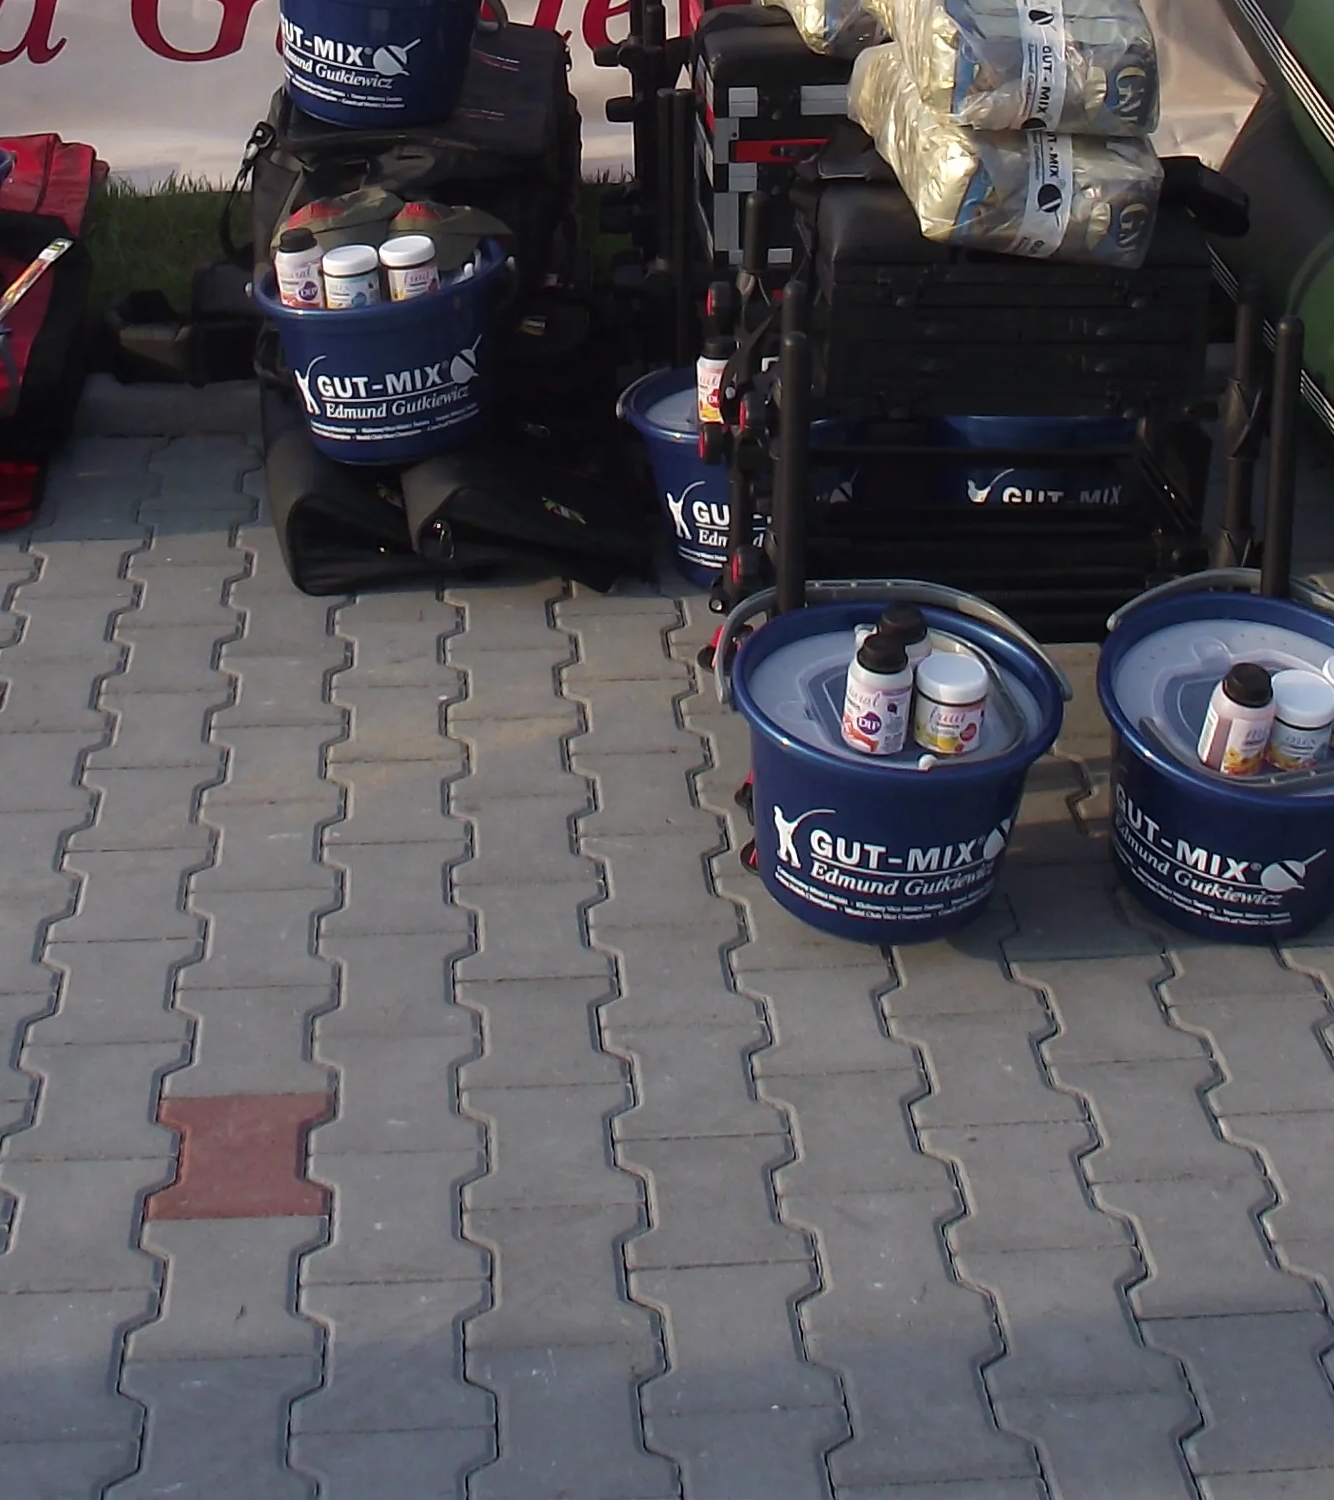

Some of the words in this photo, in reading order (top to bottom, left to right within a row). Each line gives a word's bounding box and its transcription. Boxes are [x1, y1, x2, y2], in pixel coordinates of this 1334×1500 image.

[315, 62, 394, 89] Gutkiewicz
[318, 362, 444, 398] GUT-MIX
[325, 402, 387, 420] Edmund
[391, 386, 469, 416] Gutkiewicz
[810, 829, 978, 872] GUT-MIX
[810, 860, 899, 896] Edmund
[1174, 868, 1284, 906] Gutkiewicz
